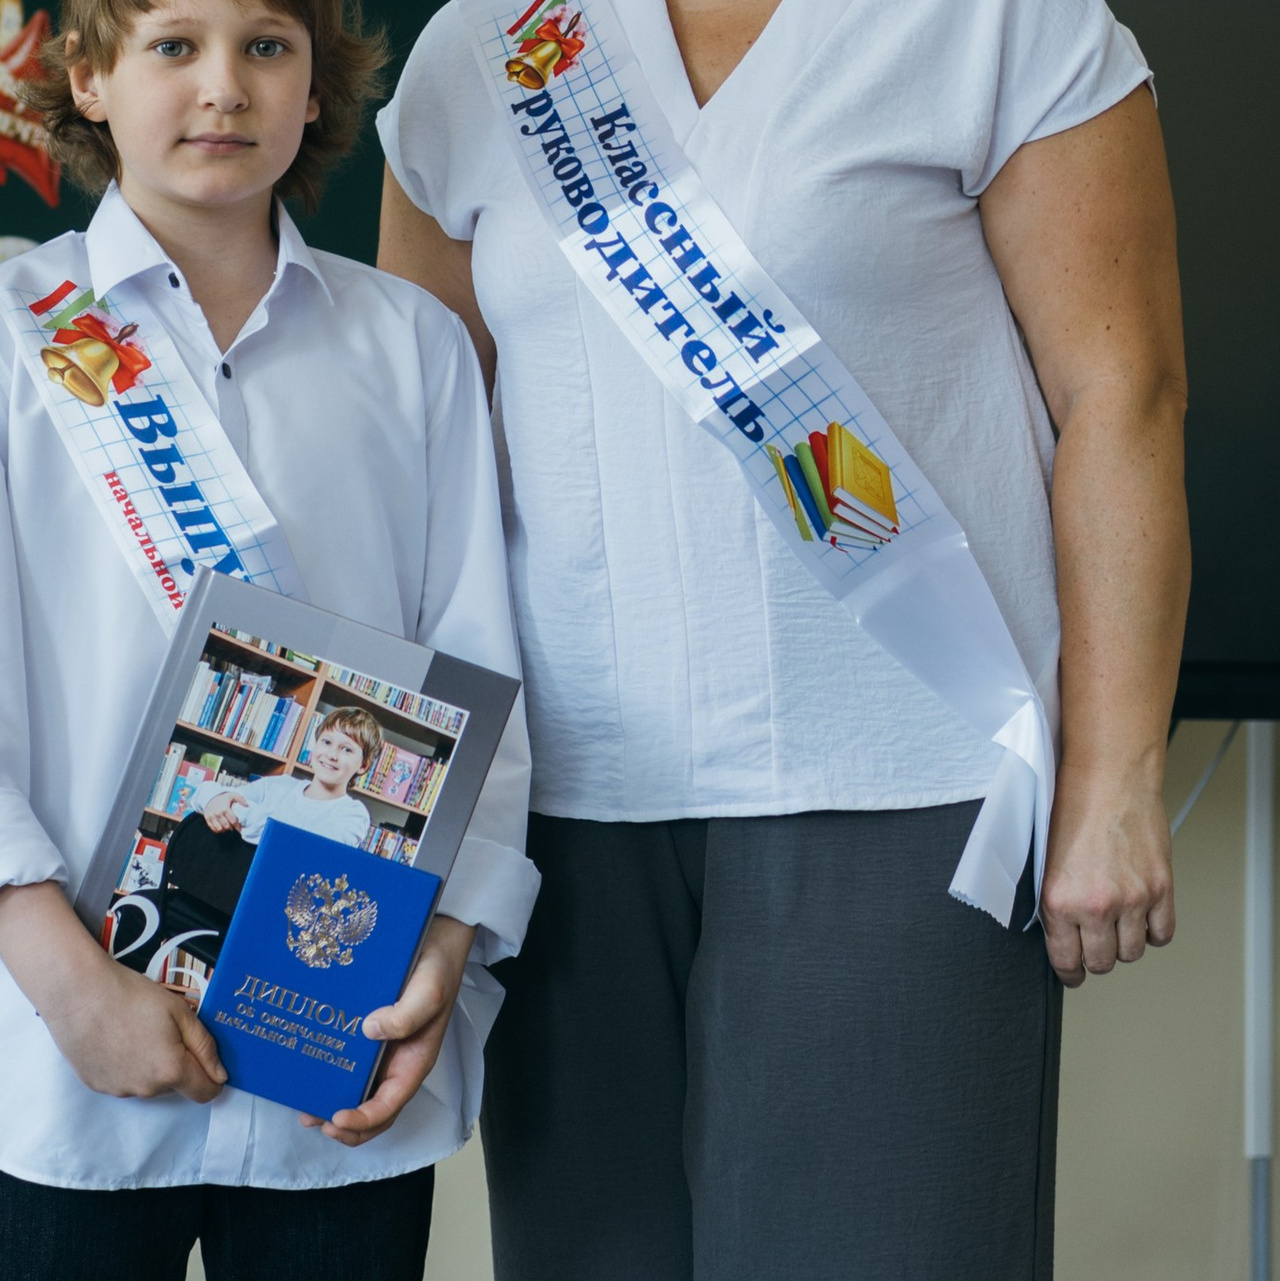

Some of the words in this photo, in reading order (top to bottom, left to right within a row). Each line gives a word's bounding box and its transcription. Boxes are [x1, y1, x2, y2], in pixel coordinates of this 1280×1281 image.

[511, 90, 766, 443] руководитель
[591, 103, 786, 364] Классный
[103, 470, 187, 610] начальной
[215, 1010, 297, 1050] НАЧАЛЬНОЙ
[301, 1042, 357, 1072] ШКОЛЫ
[234, 974, 363, 1036] ДИПЛОМ
[236, 1002, 256, 1019] ОБ
[260, 1011, 346, 1051] ОКОНЧАНИИ
